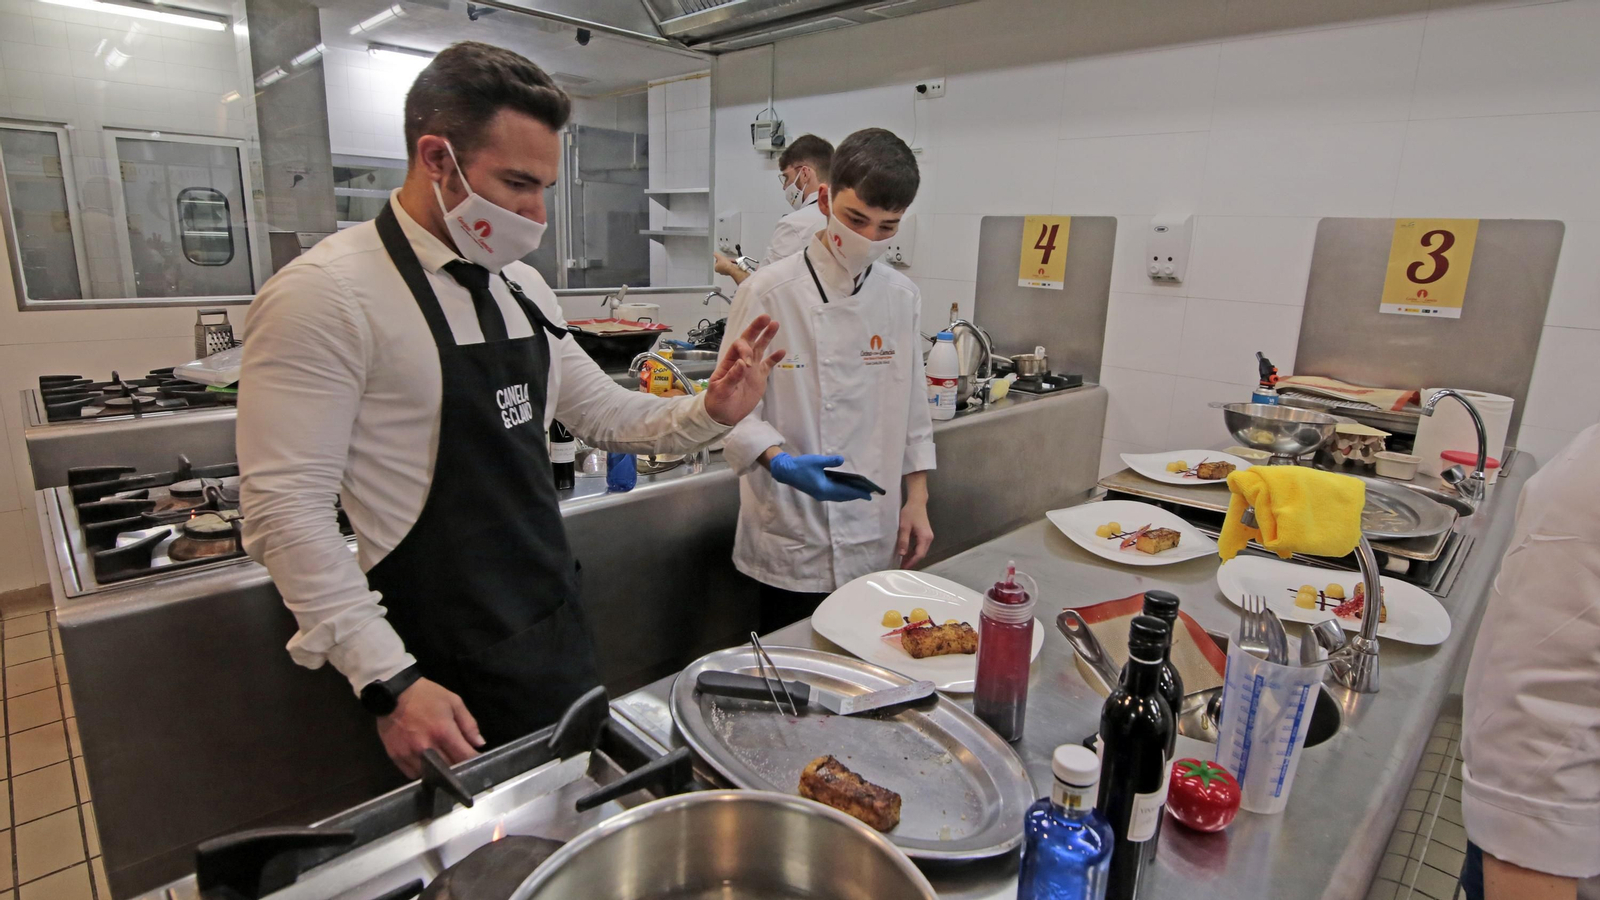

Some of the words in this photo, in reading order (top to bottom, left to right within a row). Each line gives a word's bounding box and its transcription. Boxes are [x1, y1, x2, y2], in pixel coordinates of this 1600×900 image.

[1034, 223, 1060, 265] 4
[1406, 229, 1456, 285] 3
[496, 383, 529, 410] CANELA
